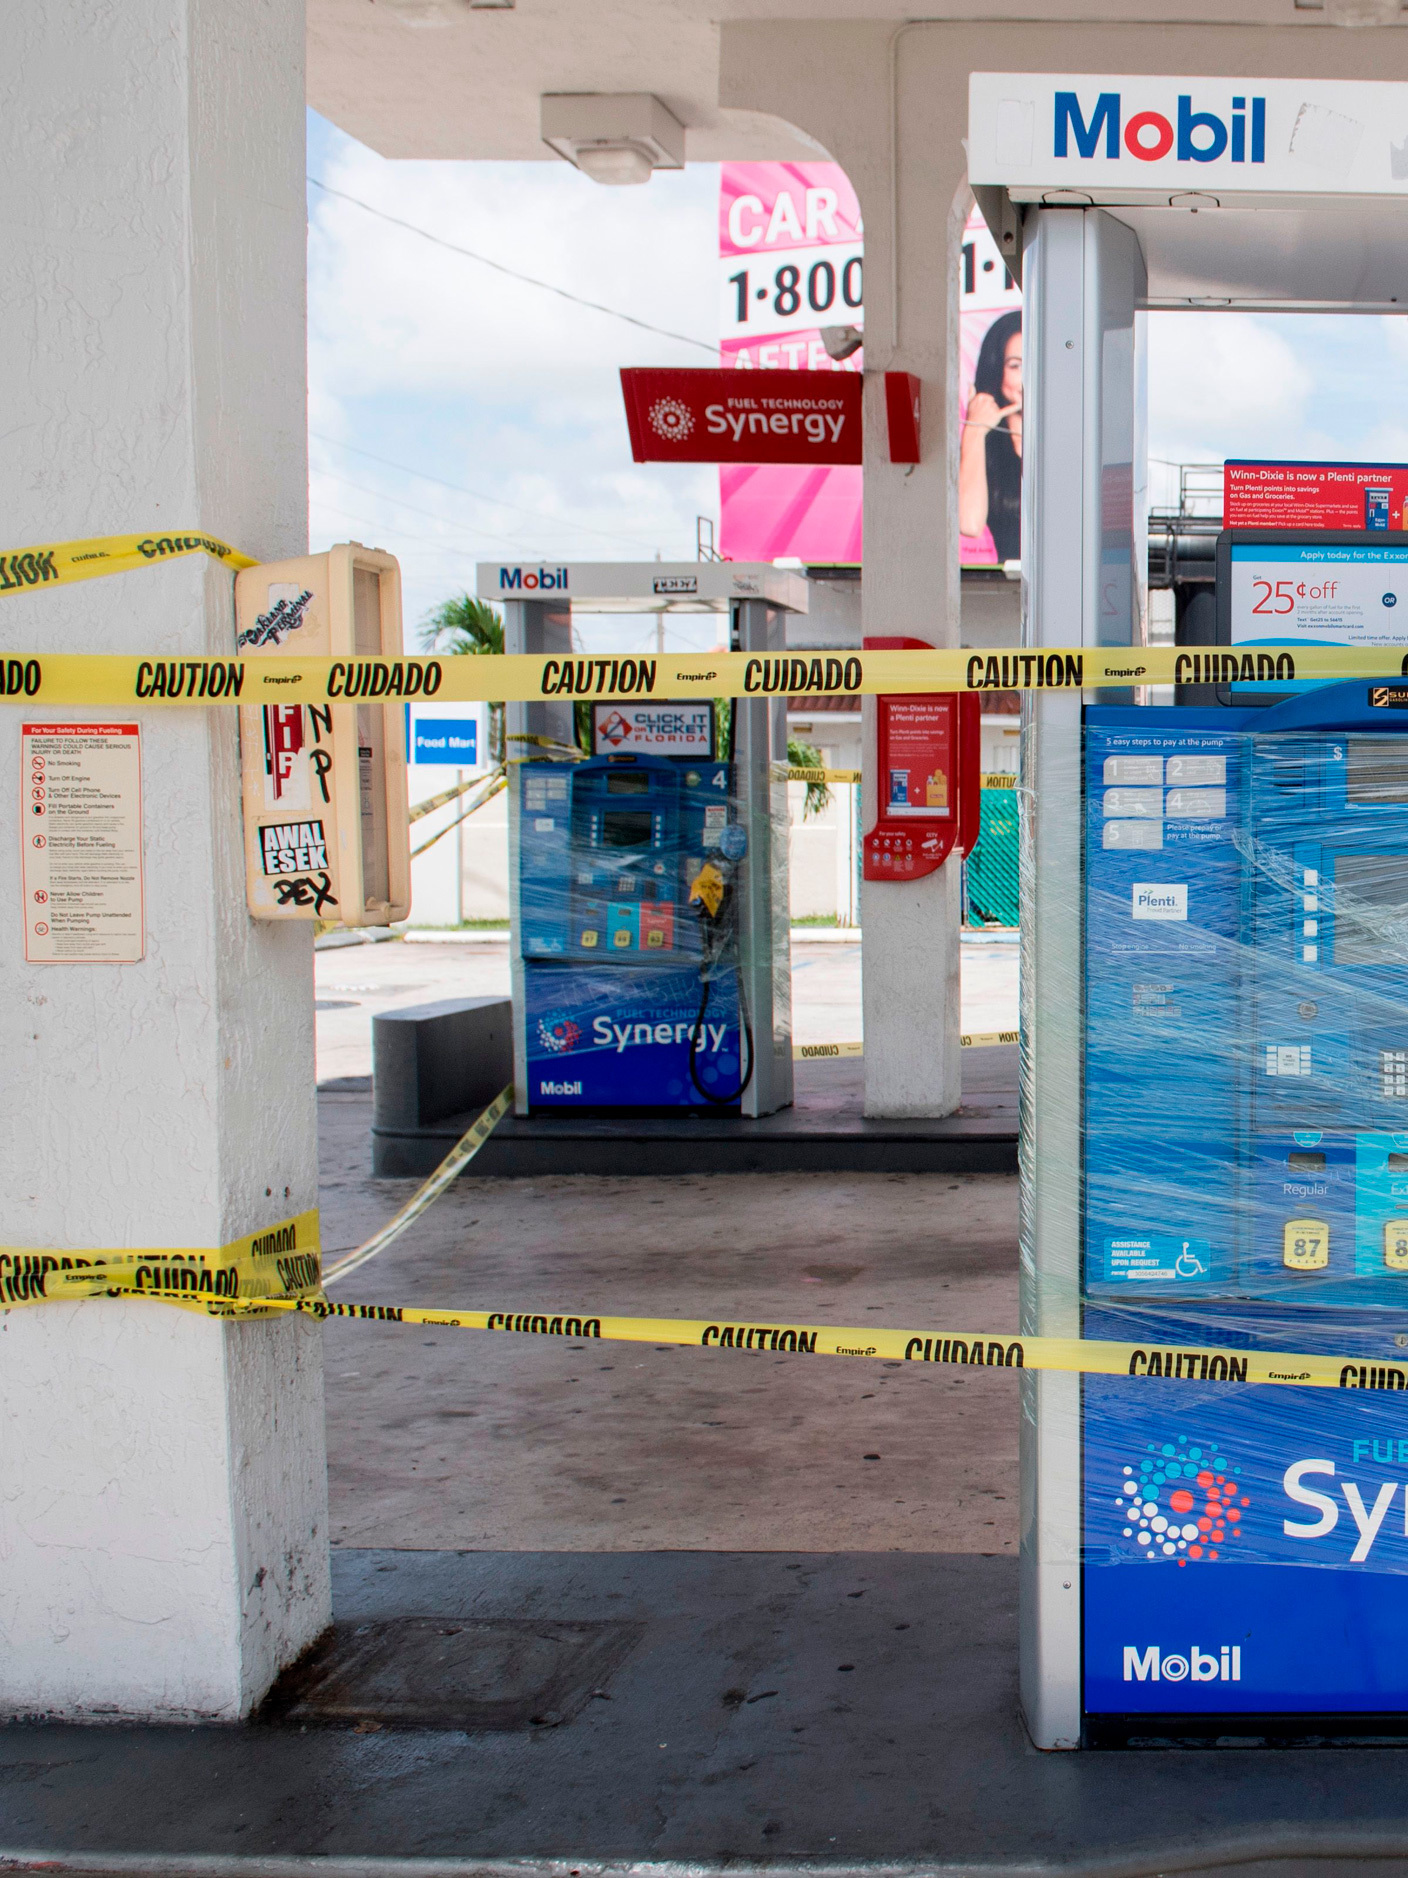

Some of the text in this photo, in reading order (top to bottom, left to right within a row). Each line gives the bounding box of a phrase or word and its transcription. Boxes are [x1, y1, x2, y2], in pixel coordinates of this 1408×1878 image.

[1054, 91, 1267, 164] Mobil
[728, 188, 839, 248] CAR
[728, 398, 844, 410] FUEL TECHNOLOGY
[705, 405, 846, 444] Synergy
[1230, 470, 1284, 480] Winn-Dixie
[1287, 471, 1294, 480] is
[1296, 473, 1317, 481] now
[1327, 472, 1355, 481] Plenti
[1357, 473, 1392, 484] partner
[1264, 485, 1283, 493] points
[1297, 486, 1319, 494] savings
[1300, 551, 1324, 561] Apply
[1327, 552, 1350, 561] today
[1353, 551, 1365, 559] for
[500, 568, 568, 589] Mobil
[1310, 581, 1339, 599] off
[135, 662, 245, 698] CAUTION
[263, 675, 302, 685] Empire
[327, 661, 442, 698] CUIDADO
[541, 659, 656, 695] CAUTION
[676, 671, 717, 682] Empire
[744, 657, 862, 692] CUIDADO
[967, 654, 1083, 689] CAUTION
[1104, 666, 1146, 678] Empire
[1174, 652, 1294, 684] CUIDADO
[635, 713, 707, 724] CLICK IT
[57, 727, 76, 735] Safety
[77, 727, 97, 735] During
[99, 727, 122, 735] Fueling
[646, 724, 707, 734] TICKET
[416, 736, 476, 748] Food Mart
[635, 735, 708, 743] FLORIDA
[1106, 738, 1112, 746] 5
[1113, 739, 1130, 747] easy
[1132, 738, 1151, 747] steps
[1163, 739, 1176, 748] pay
[1187, 738, 1199, 746] the
[1201, 739, 1224, 747] pump
[711, 770, 727, 789] 4
[264, 823, 325, 851] AWAL
[264, 846, 329, 875] ESEK
[1138, 894, 1176, 907] Plenti
[649, 1009, 727, 1018] TECHNOOGY
[592, 1016, 727, 1053] Synergy
[540, 1081, 582, 1096] Mobil
[1283, 1183, 1329, 1198] Regular
[1293, 1239, 1321, 1257] 87
[487, 1313, 601, 1338] CUIDADO
[701, 1324, 818, 1354] CAUTION
[905, 1337, 1024, 1368] CUIDADO
[1129, 1349, 1248, 1383] CAUTION
[1124, 1646, 1241, 1682] Mobil
